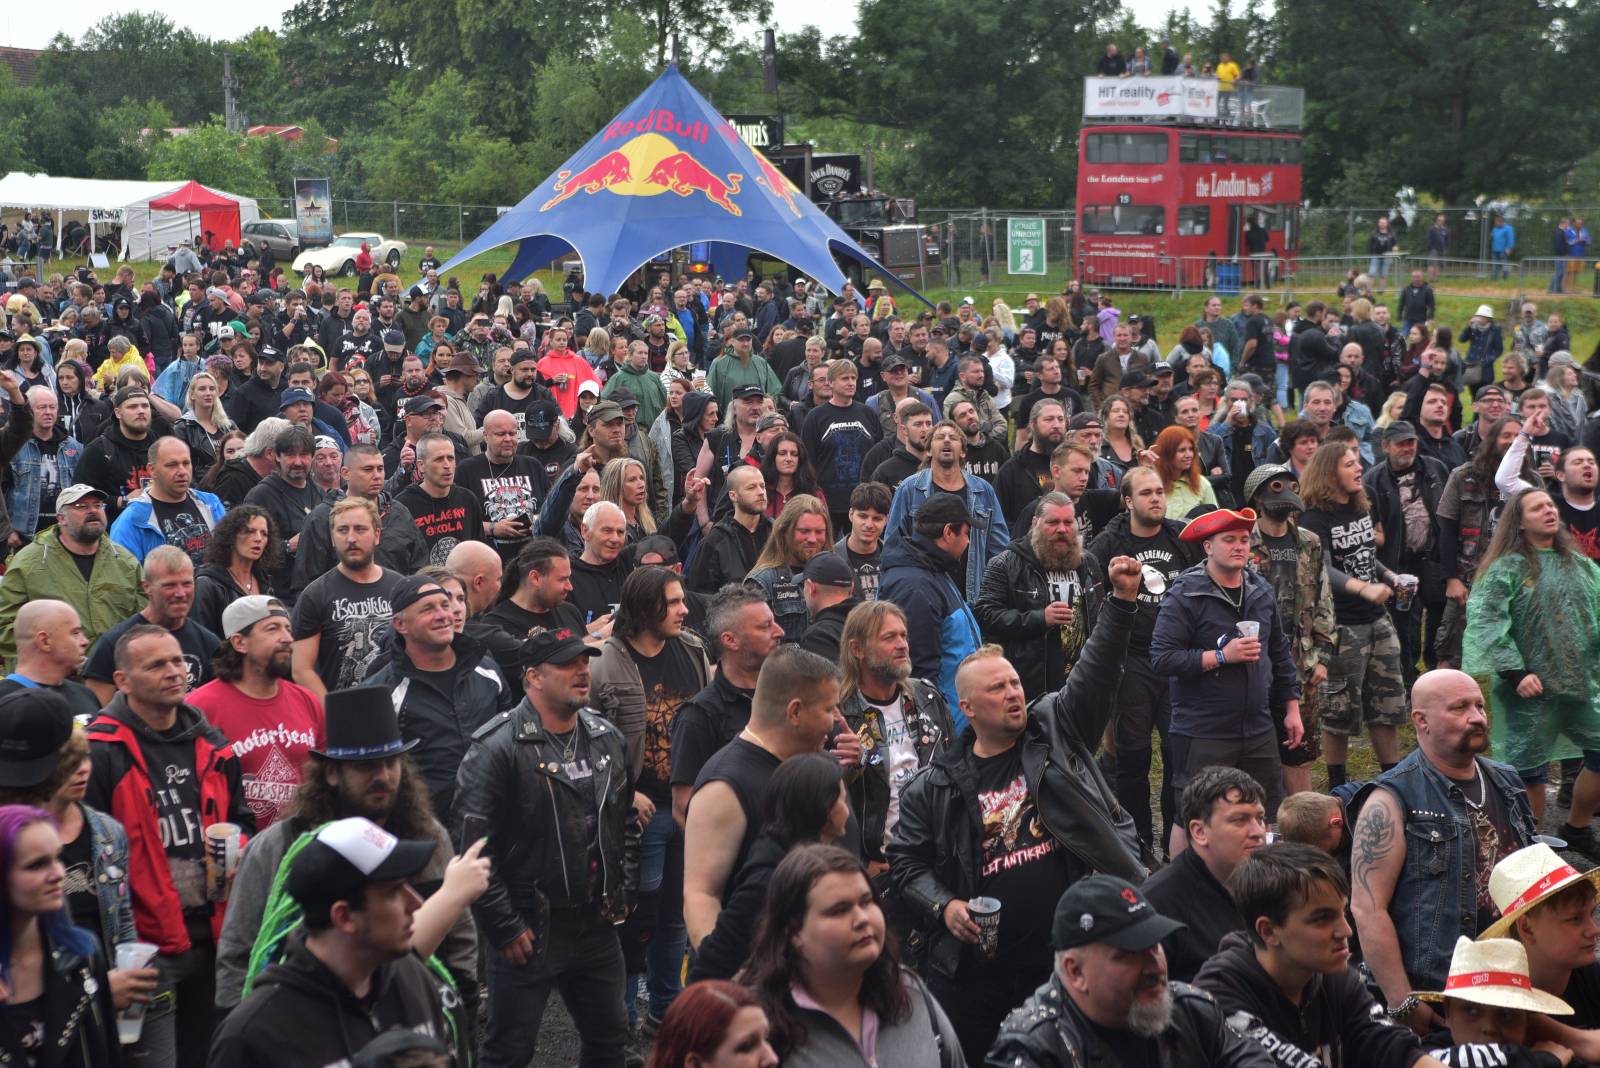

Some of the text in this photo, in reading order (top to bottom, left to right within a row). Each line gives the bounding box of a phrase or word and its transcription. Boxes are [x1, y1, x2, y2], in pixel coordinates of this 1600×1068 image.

[1098, 86, 1155, 100] HIT reality
[810, 167, 826, 183] JACK
[1101, 174, 1135, 183] London
[1196, 172, 1259, 197] the London bus
[821, 420, 872, 441] METALLICA
[165, 764, 191, 785] Run
[157, 788, 181, 807] TH
[270, 783, 299, 800] SPA
[982, 856, 1004, 877] LET
